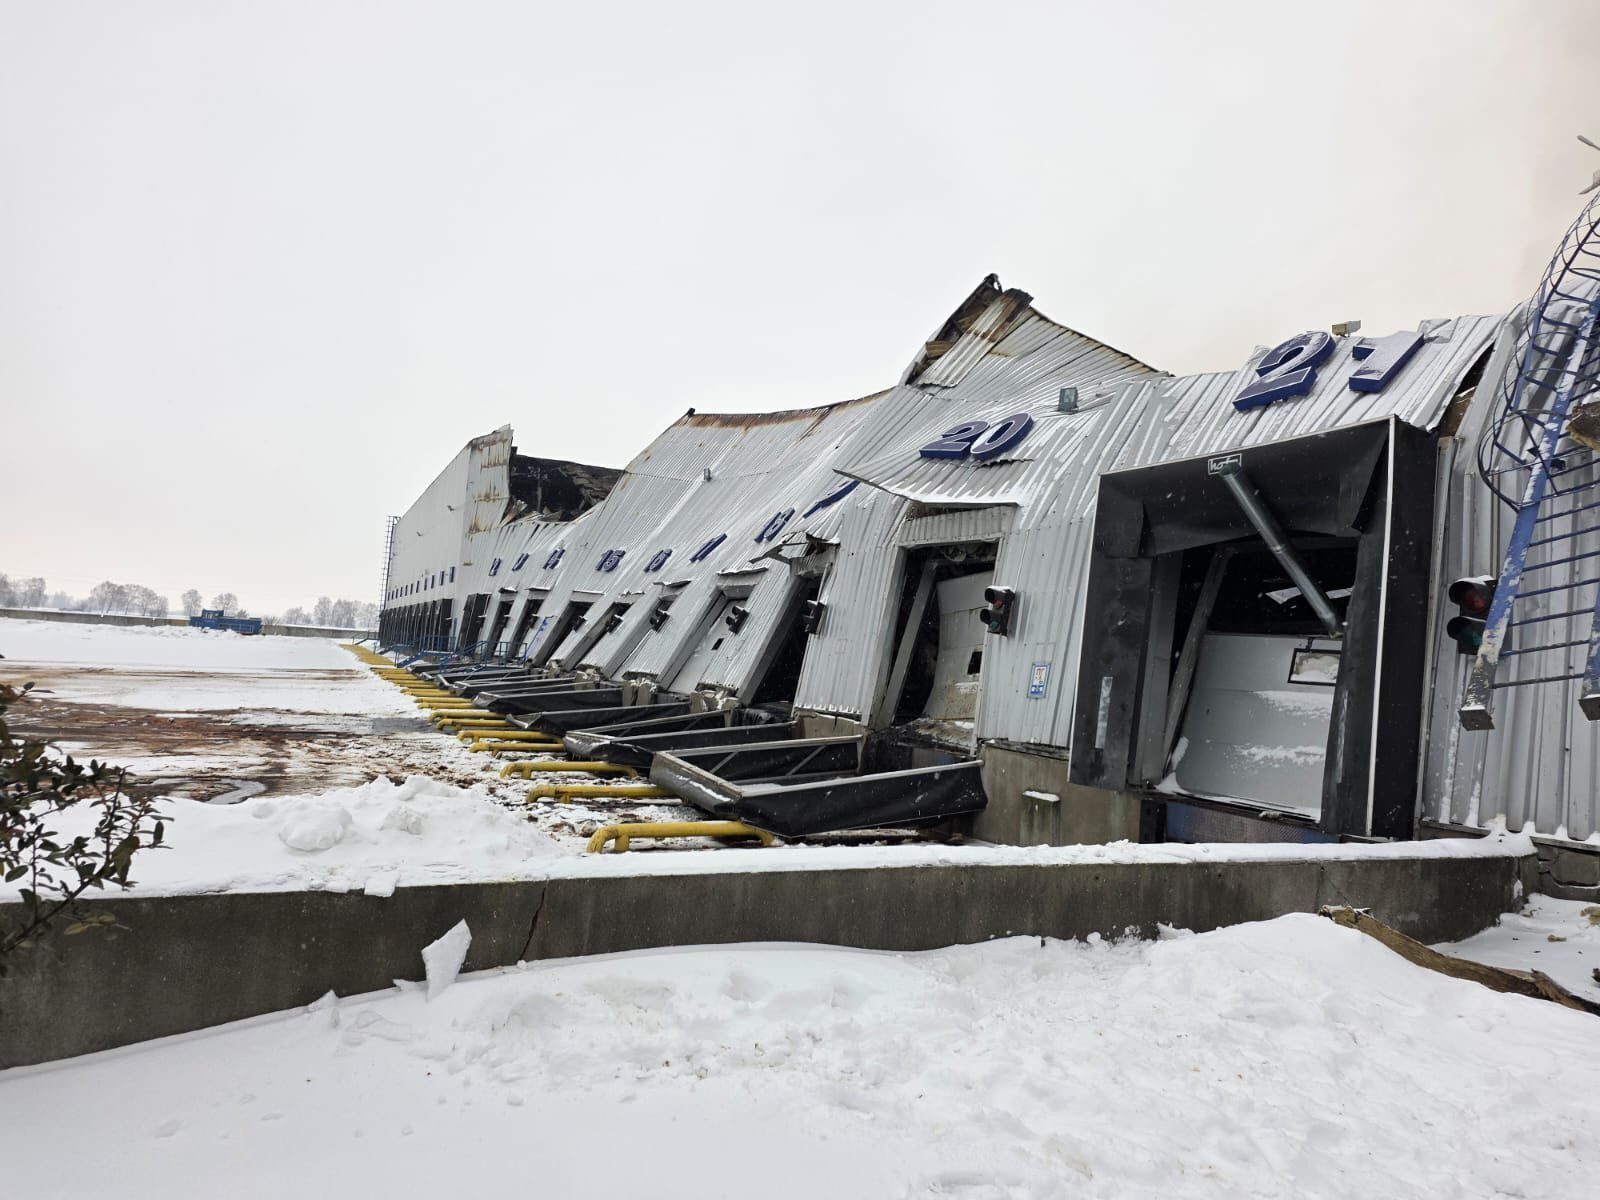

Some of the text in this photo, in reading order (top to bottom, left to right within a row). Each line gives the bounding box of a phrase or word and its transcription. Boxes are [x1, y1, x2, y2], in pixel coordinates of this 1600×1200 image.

[1232, 330, 1425, 412] 21
[919, 412, 1034, 461] 20
[754, 507, 796, 544] 18
[595, 549, 626, 573] 15
